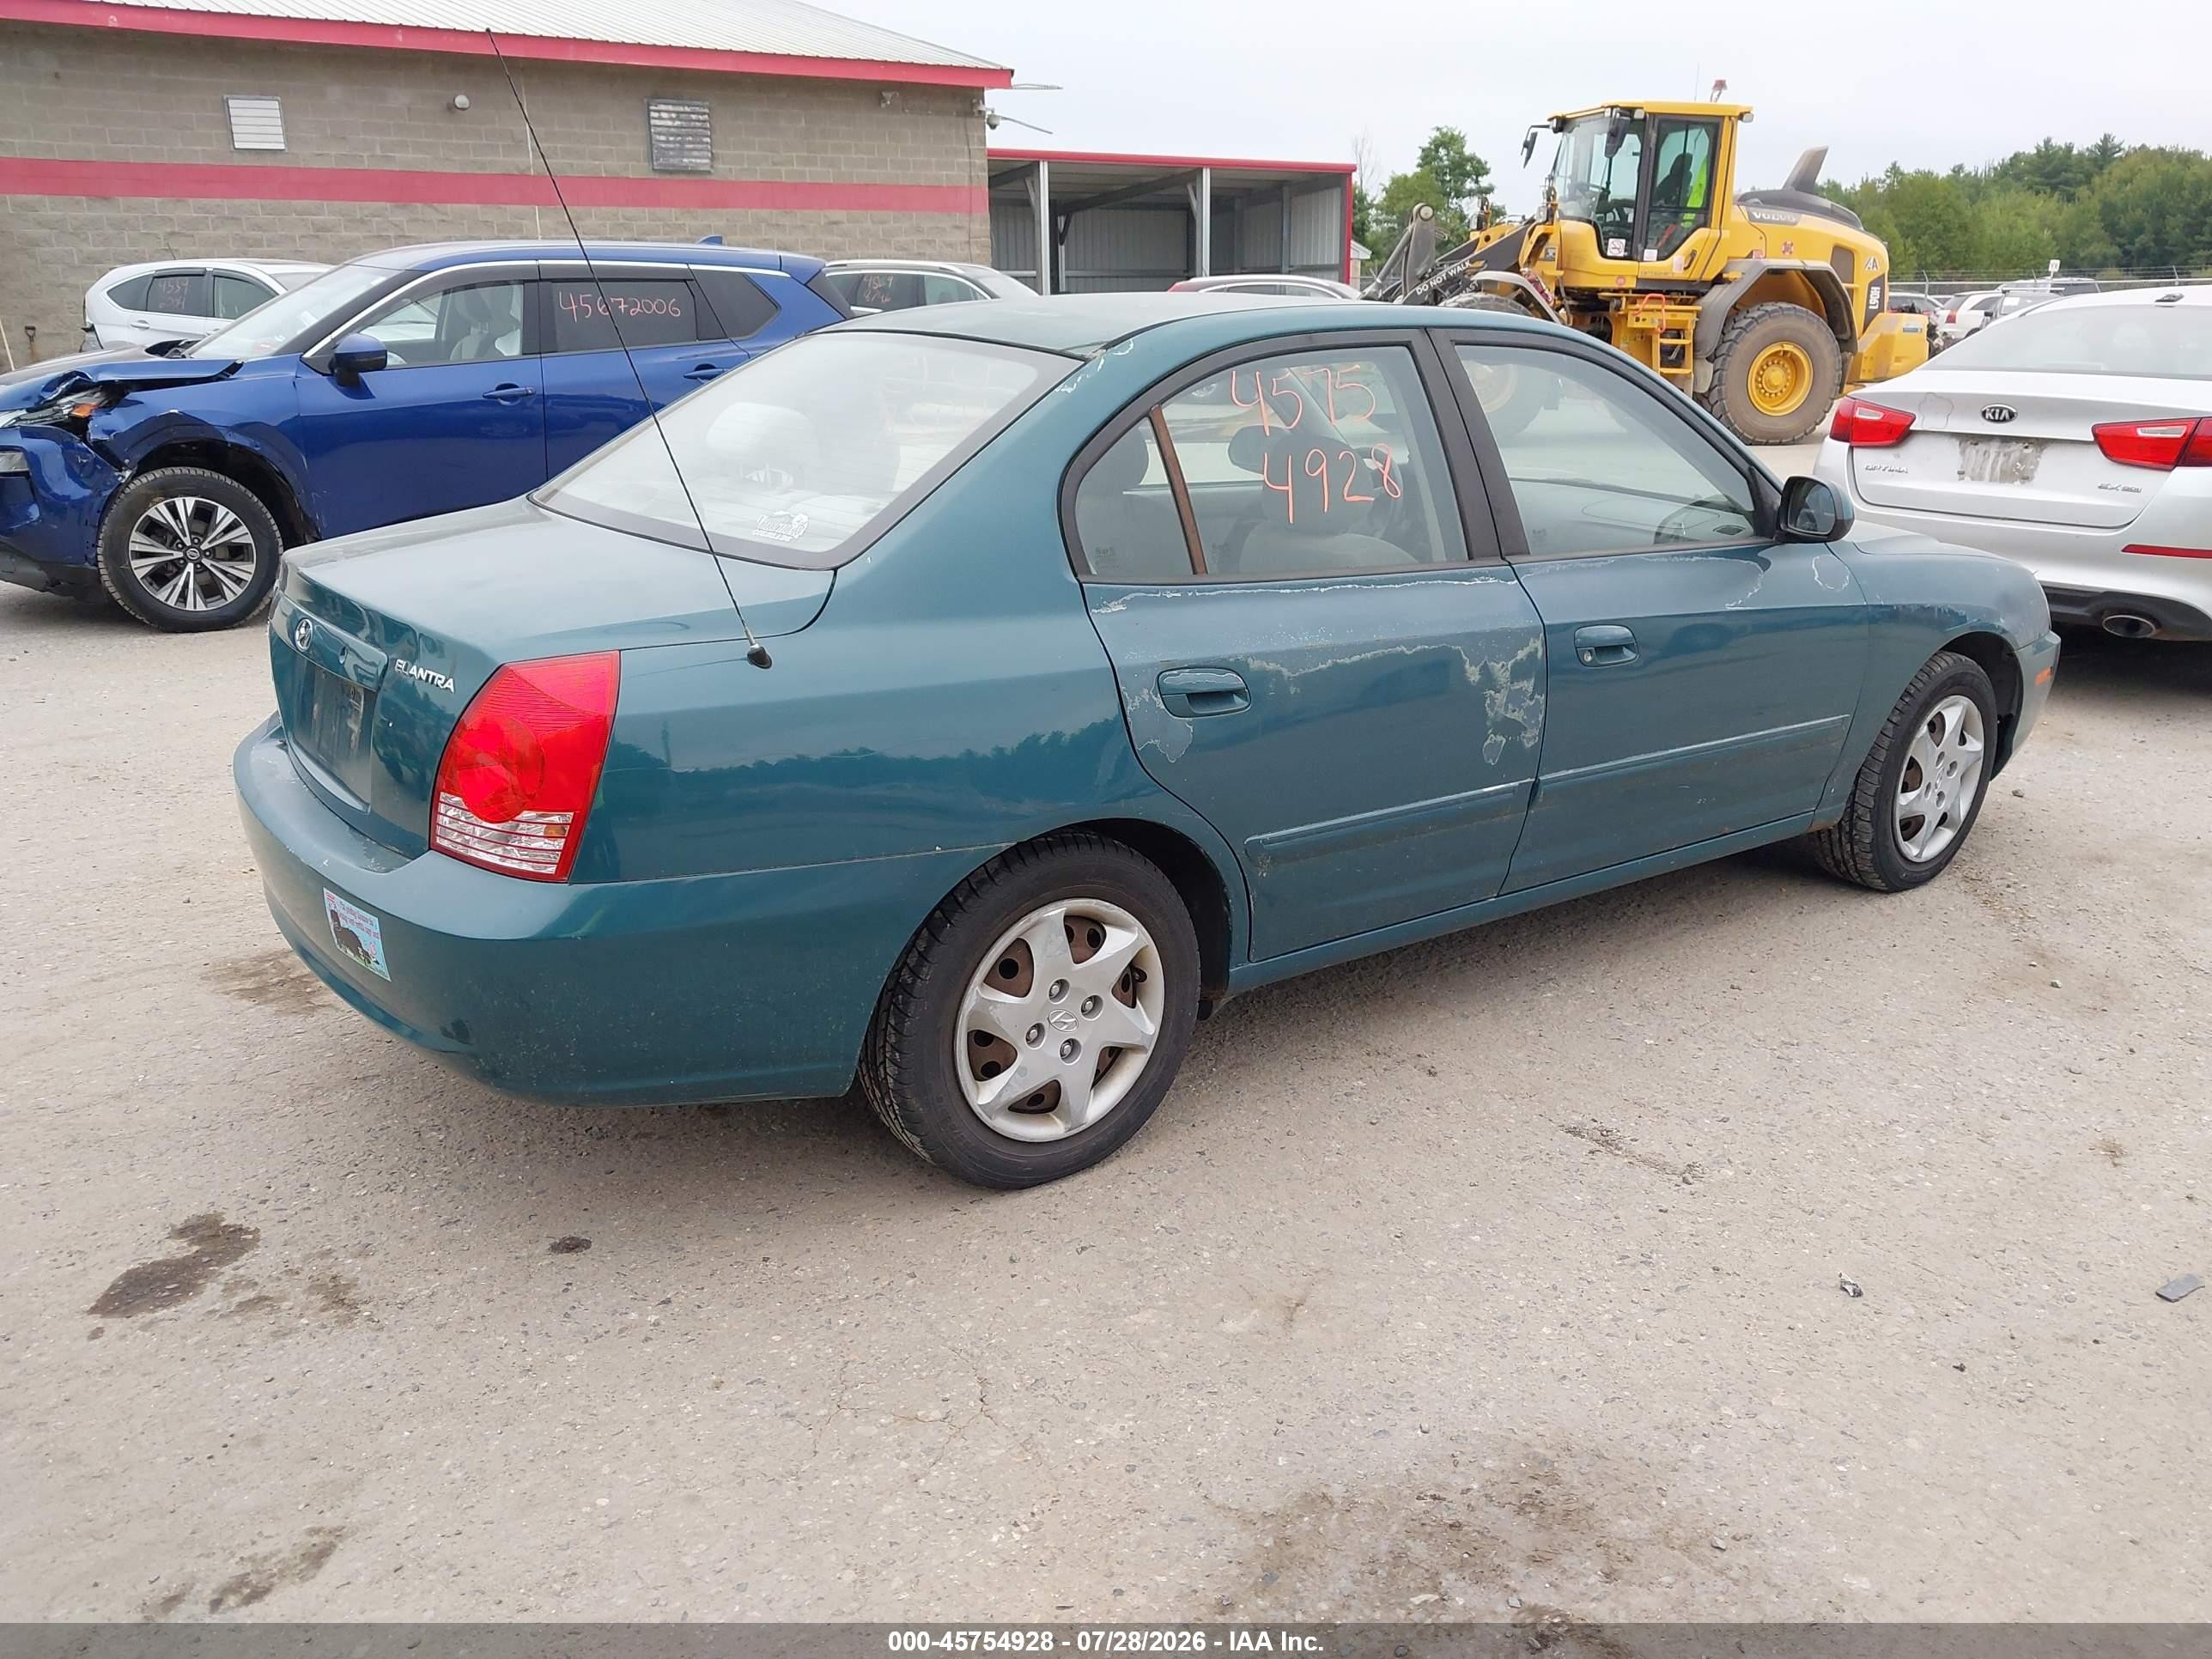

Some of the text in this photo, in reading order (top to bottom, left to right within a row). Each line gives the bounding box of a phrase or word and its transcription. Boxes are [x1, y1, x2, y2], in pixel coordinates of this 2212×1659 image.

[1416, 259, 1472, 295] DO NOT WALK
[559, 291, 681, 323] 45672006
[1231, 364, 1376, 436] 4575
[1985, 408, 2010, 421] KIA
[1263, 443, 1401, 524] 4928
[395, 659, 454, 693] ELANTRA
